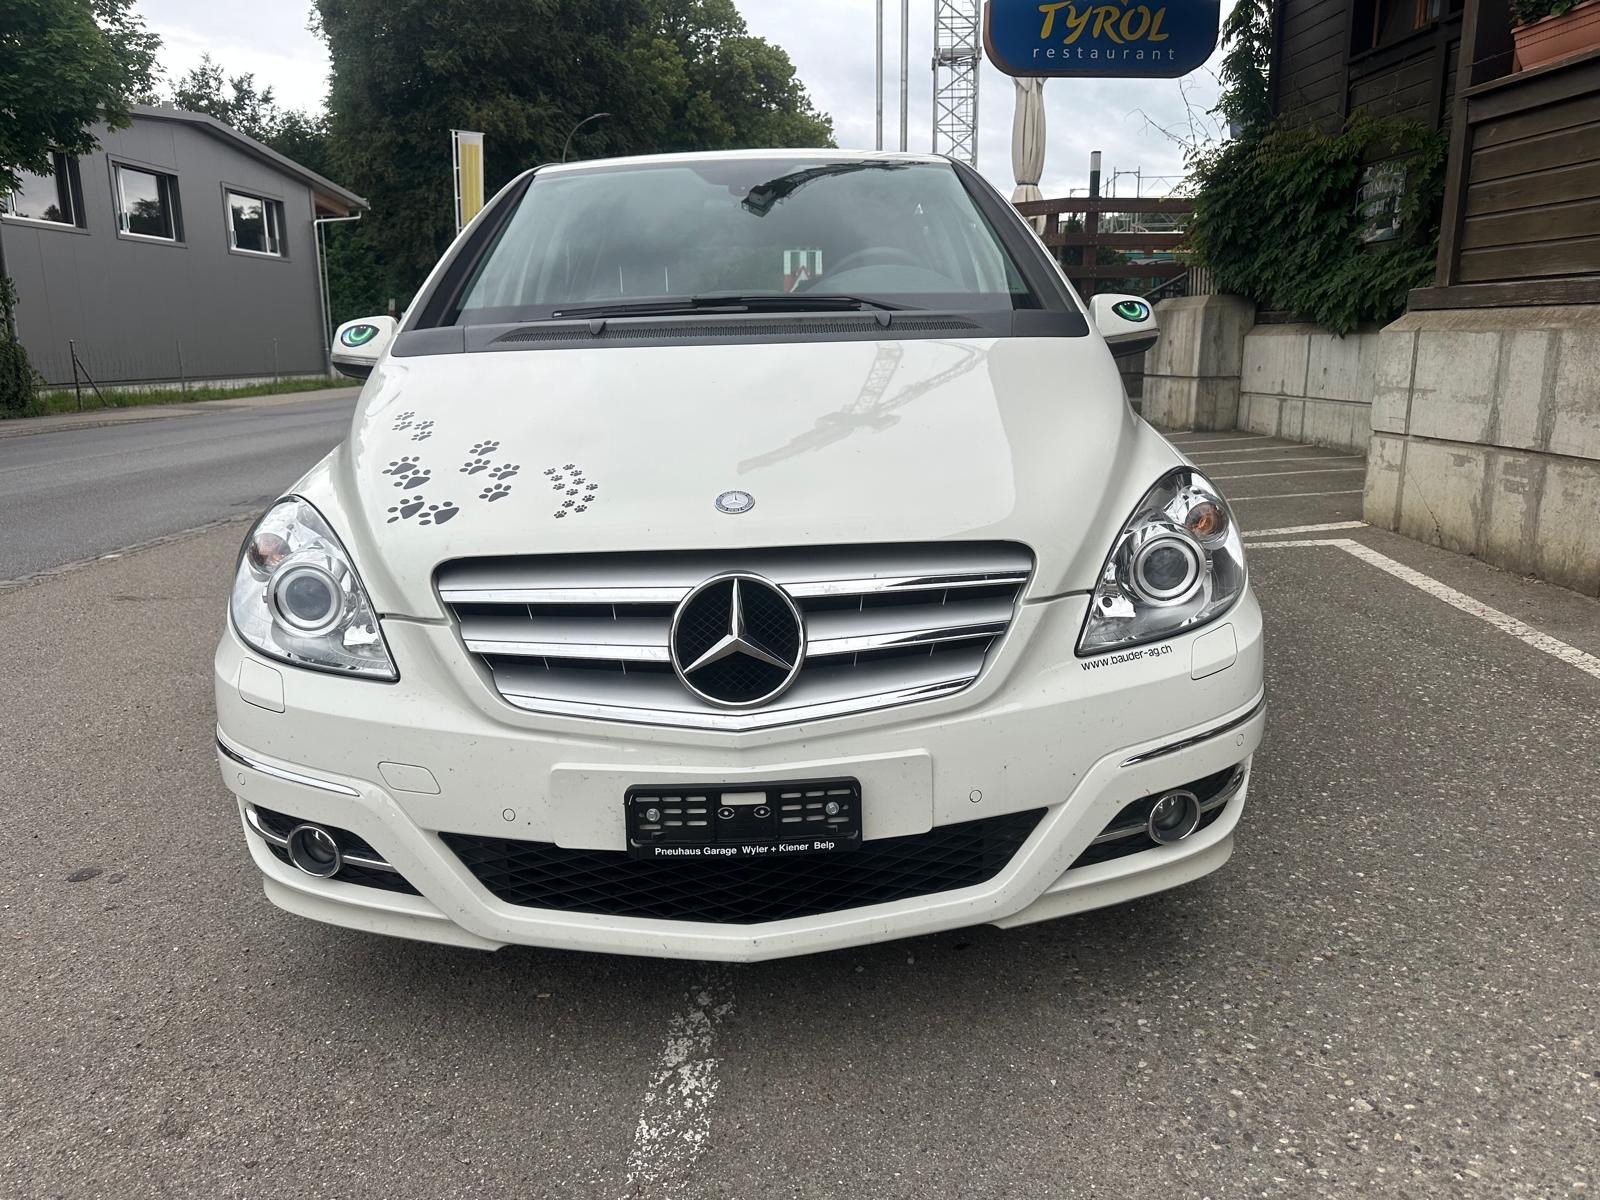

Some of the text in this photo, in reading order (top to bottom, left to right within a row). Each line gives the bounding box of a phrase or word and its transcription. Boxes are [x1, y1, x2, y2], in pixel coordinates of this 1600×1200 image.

[1038, 1, 1169, 45] TYROL
[1033, 46, 1176, 60] restaurant
[1081, 645, 1173, 671] www.bauder-ag.ch
[655, 847, 701, 856] Pneuhaus
[703, 846, 737, 856] Garage
[742, 845, 768, 856] Wyler
[779, 842, 809, 853] Kiener
[813, 841, 835, 851] Belp
